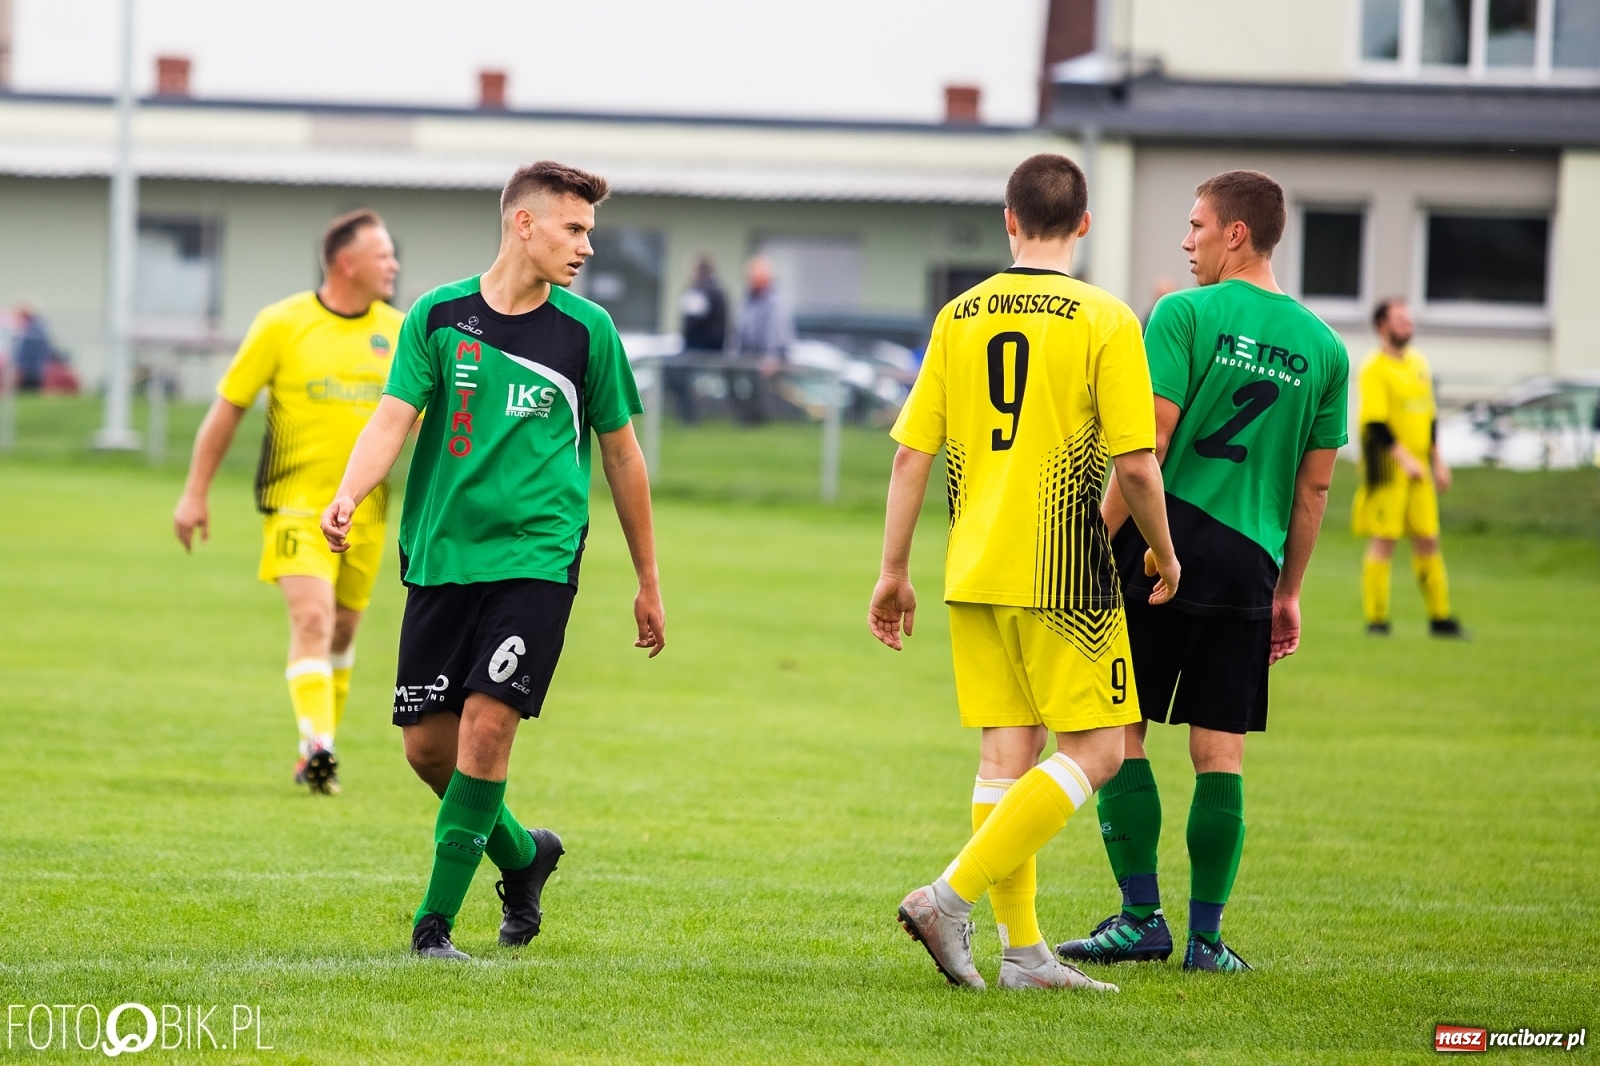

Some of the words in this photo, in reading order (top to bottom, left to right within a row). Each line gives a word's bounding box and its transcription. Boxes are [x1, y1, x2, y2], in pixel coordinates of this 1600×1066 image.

[954, 297, 981, 319] LKS
[987, 294, 1081, 320] OWSISZCZE
[1215, 355, 1301, 387] UNDERGROUND
[1217, 333, 1309, 374] METRO
[448, 340, 481, 457] METRO
[506, 383, 557, 413] LKS
[987, 331, 1030, 451] 9
[1194, 380, 1280, 464] 2
[276, 528, 299, 558] 16
[488, 635, 526, 684] 6
[1111, 658, 1127, 705] 9
